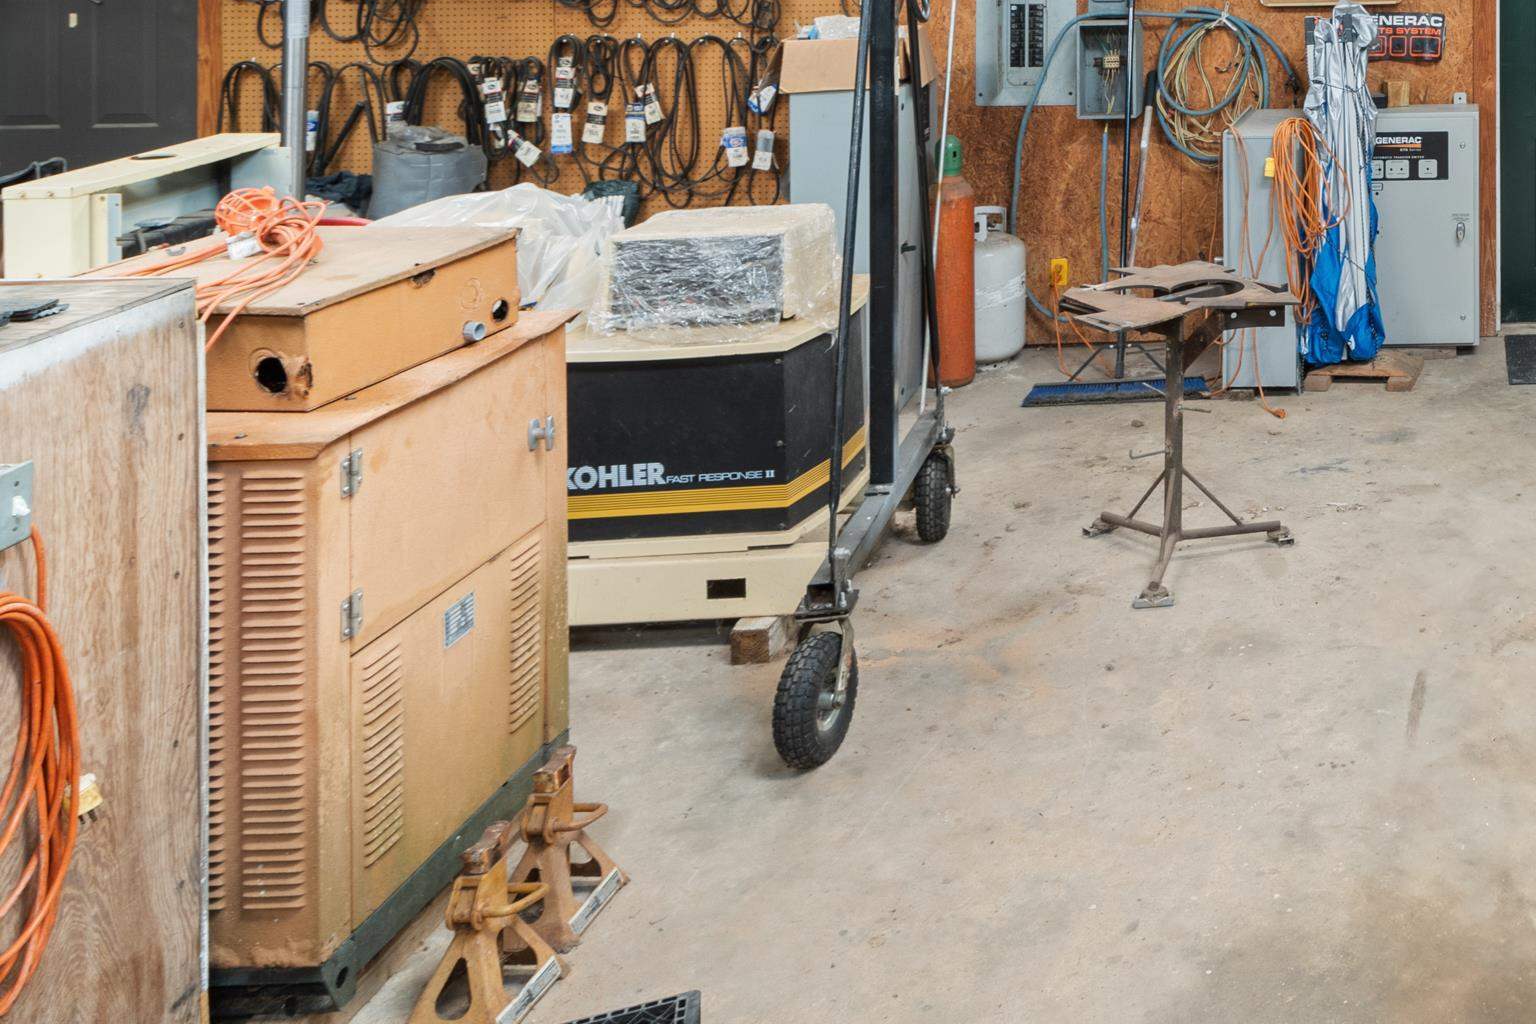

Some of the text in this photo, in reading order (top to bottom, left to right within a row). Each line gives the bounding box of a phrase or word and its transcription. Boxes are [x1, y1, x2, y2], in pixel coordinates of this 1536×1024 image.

[1370, 14, 1443, 27] ENERAC
[1396, 27, 1441, 36] SYSTEM
[1375, 136, 1422, 144] GENERAC
[665, 474, 694, 484] FAST
[698, 470, 763, 482] RESPONSE
